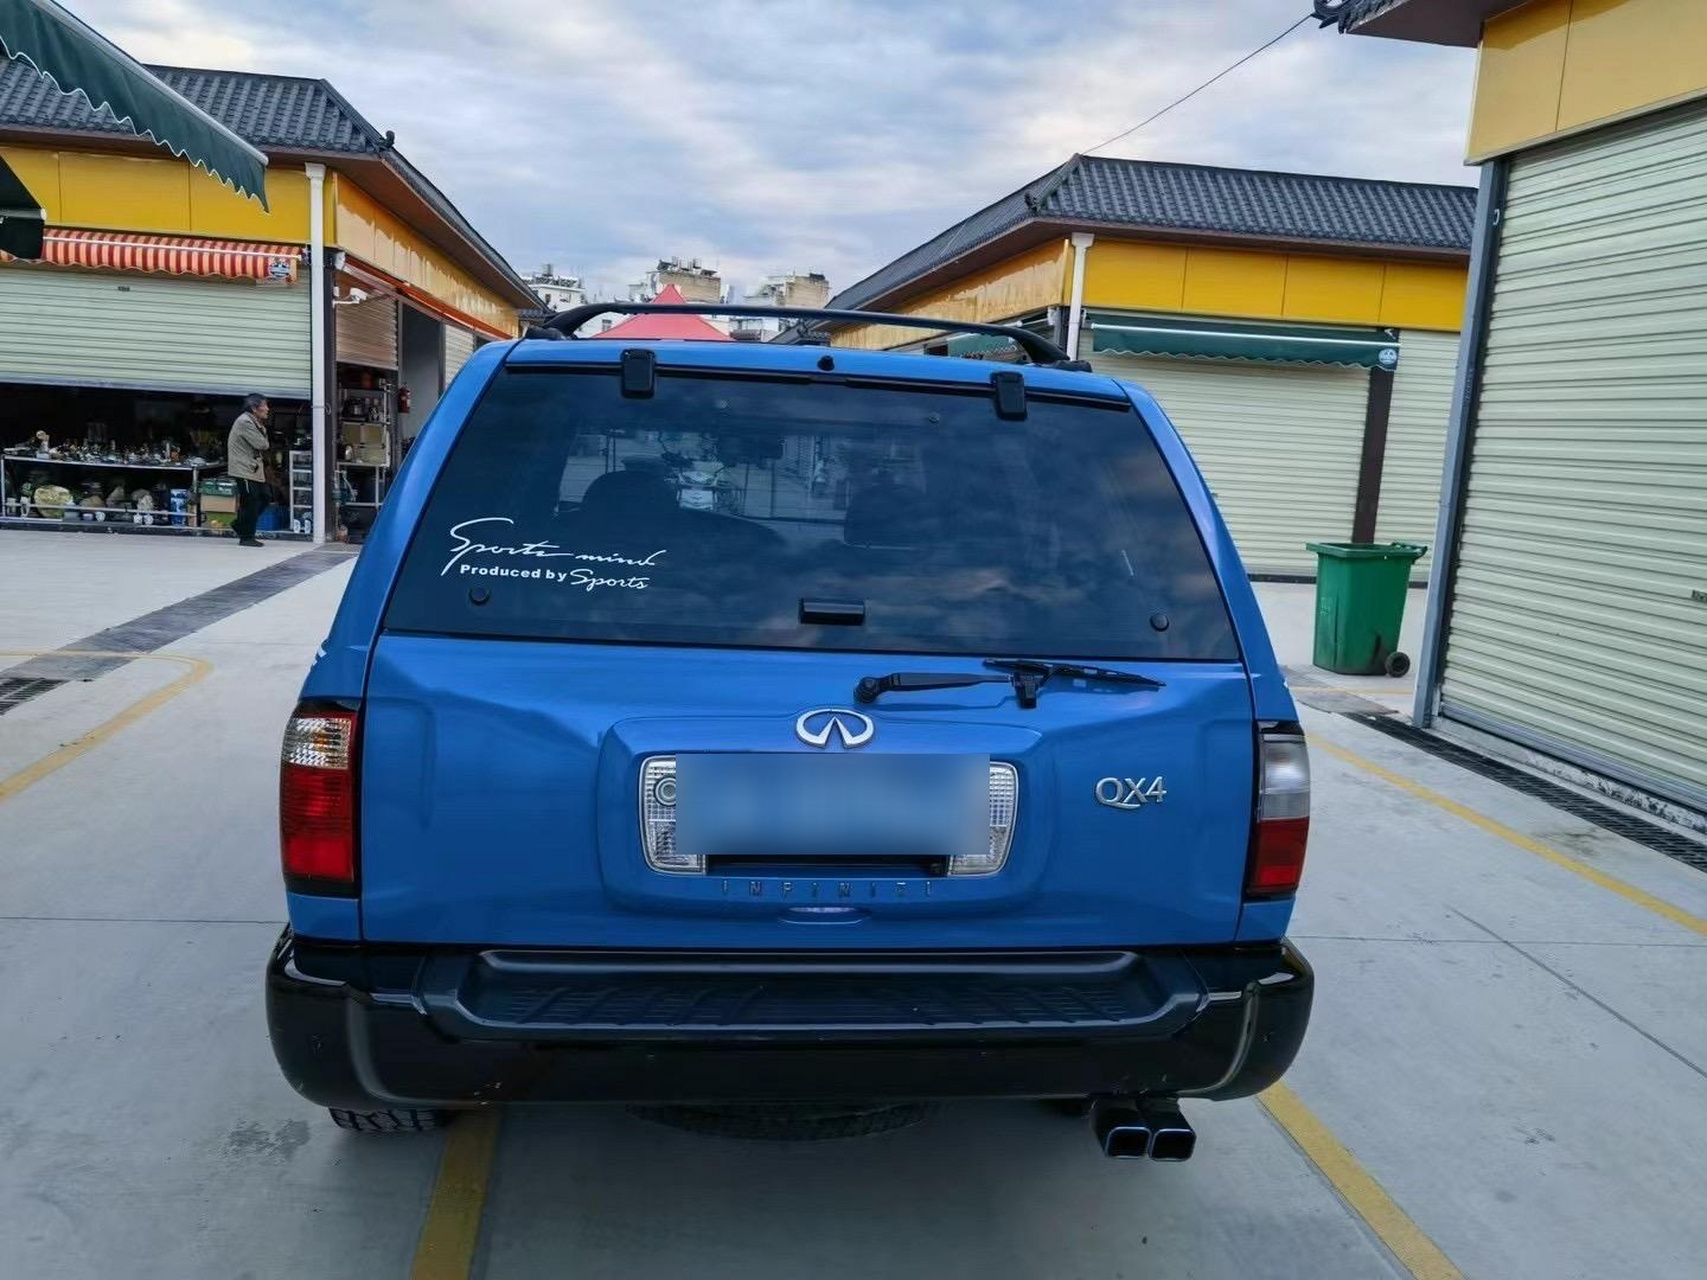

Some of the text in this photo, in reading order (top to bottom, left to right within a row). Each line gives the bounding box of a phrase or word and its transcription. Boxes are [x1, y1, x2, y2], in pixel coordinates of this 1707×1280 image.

[440, 517, 574, 576] Sports
[459, 563, 651, 592] Produced by Sports
[1095, 775, 1168, 810] QX4
[722, 879, 932, 900] INFINITI
